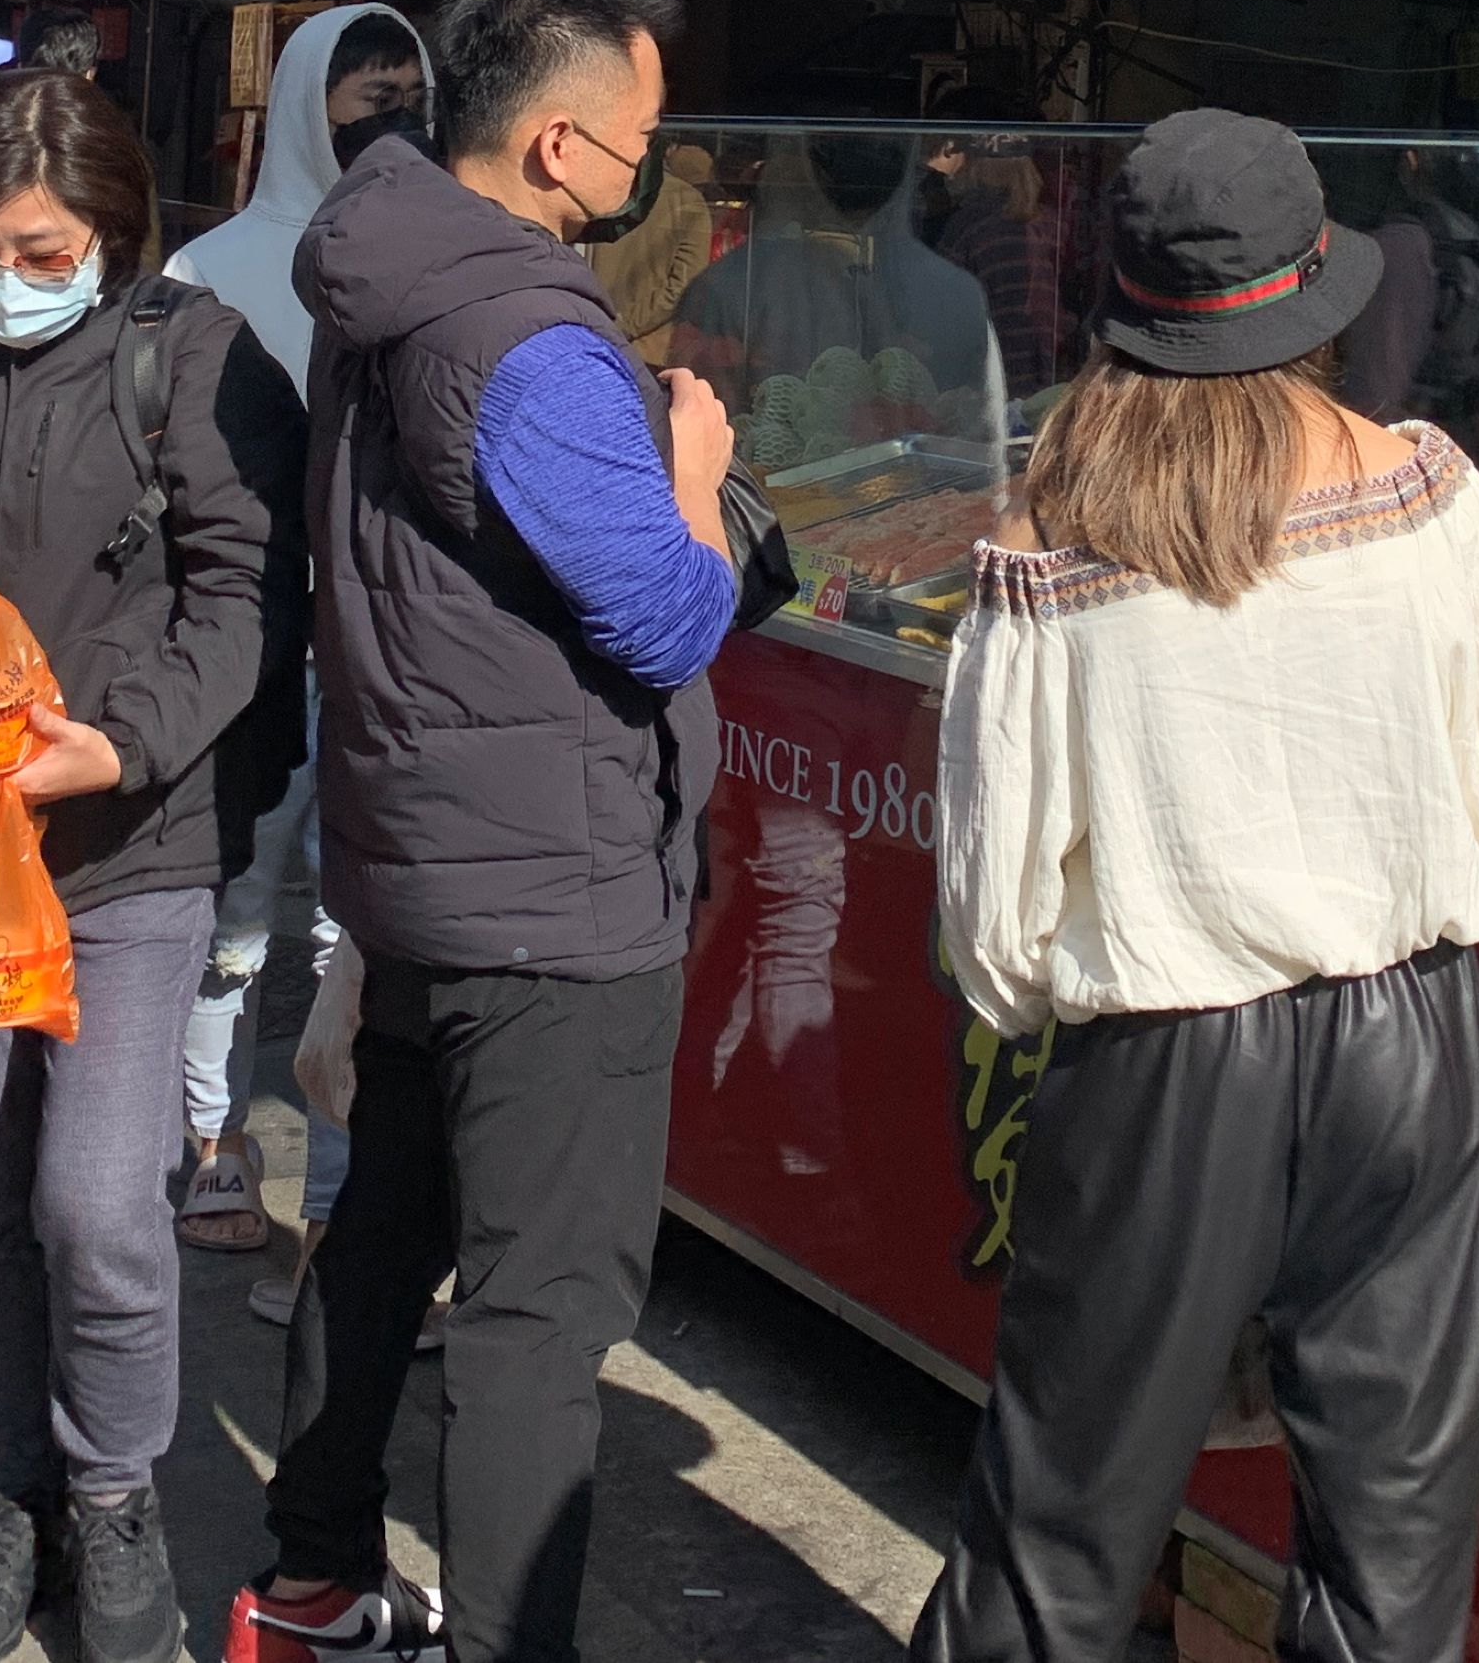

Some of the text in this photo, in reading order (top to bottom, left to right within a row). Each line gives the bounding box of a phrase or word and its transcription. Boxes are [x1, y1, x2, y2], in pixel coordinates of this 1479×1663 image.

[818, 587, 843, 614] $70
[715, 717, 938, 851] INCE 1980
[193, 1173, 246, 1200] FILA
